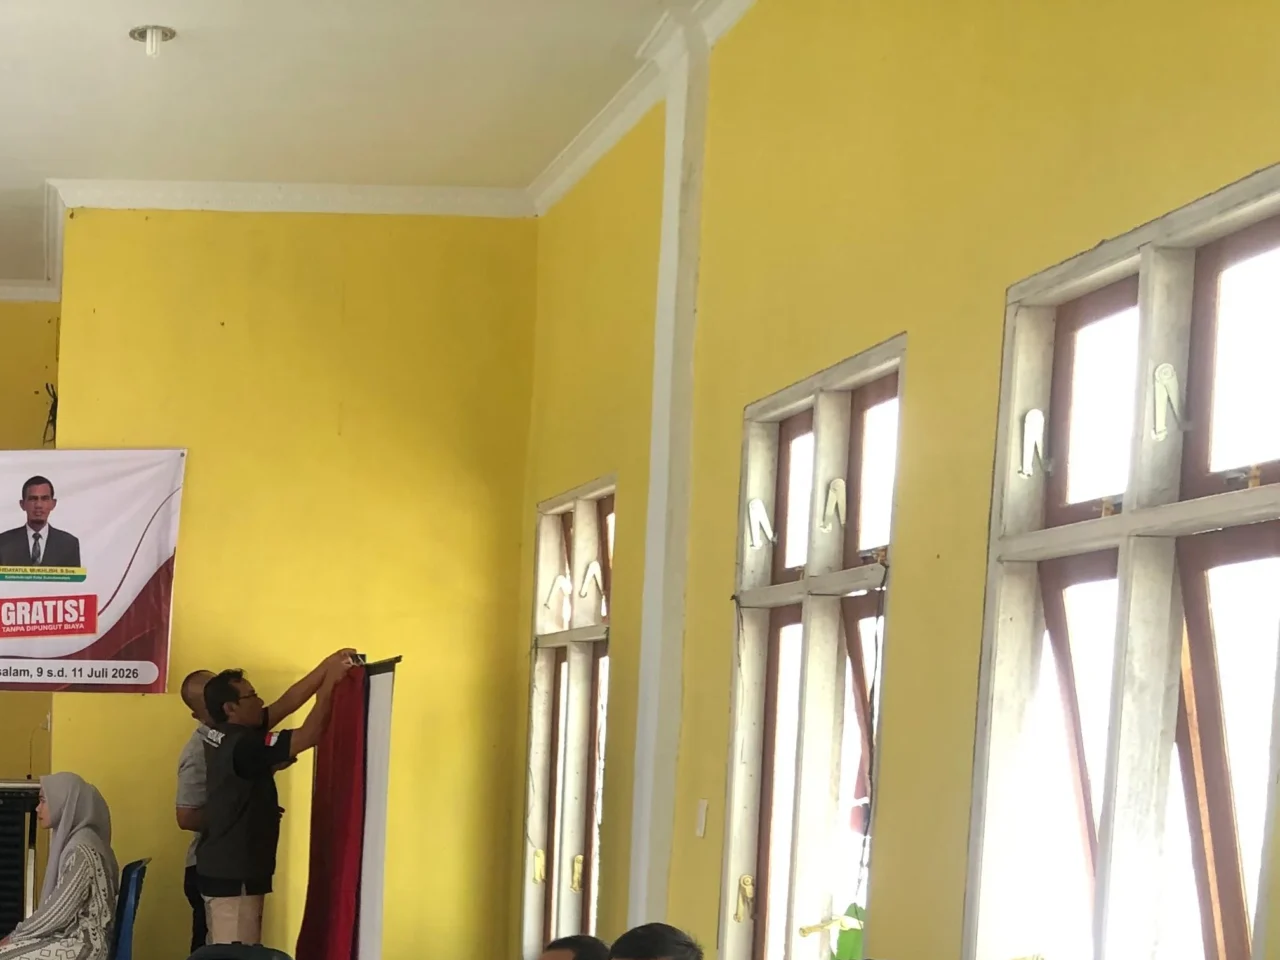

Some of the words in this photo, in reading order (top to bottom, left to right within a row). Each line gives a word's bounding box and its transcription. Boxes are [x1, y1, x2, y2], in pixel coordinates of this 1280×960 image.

[1, 599, 86, 626] GRATIS!
[26, 624, 62, 632] DIPUNGUT
[37, 667, 44, 677] 9
[47, 667, 68, 678] s.d.
[71, 668, 83, 678] 11
[87, 667, 108, 679] Juli
[111, 668, 139, 679] 2026
